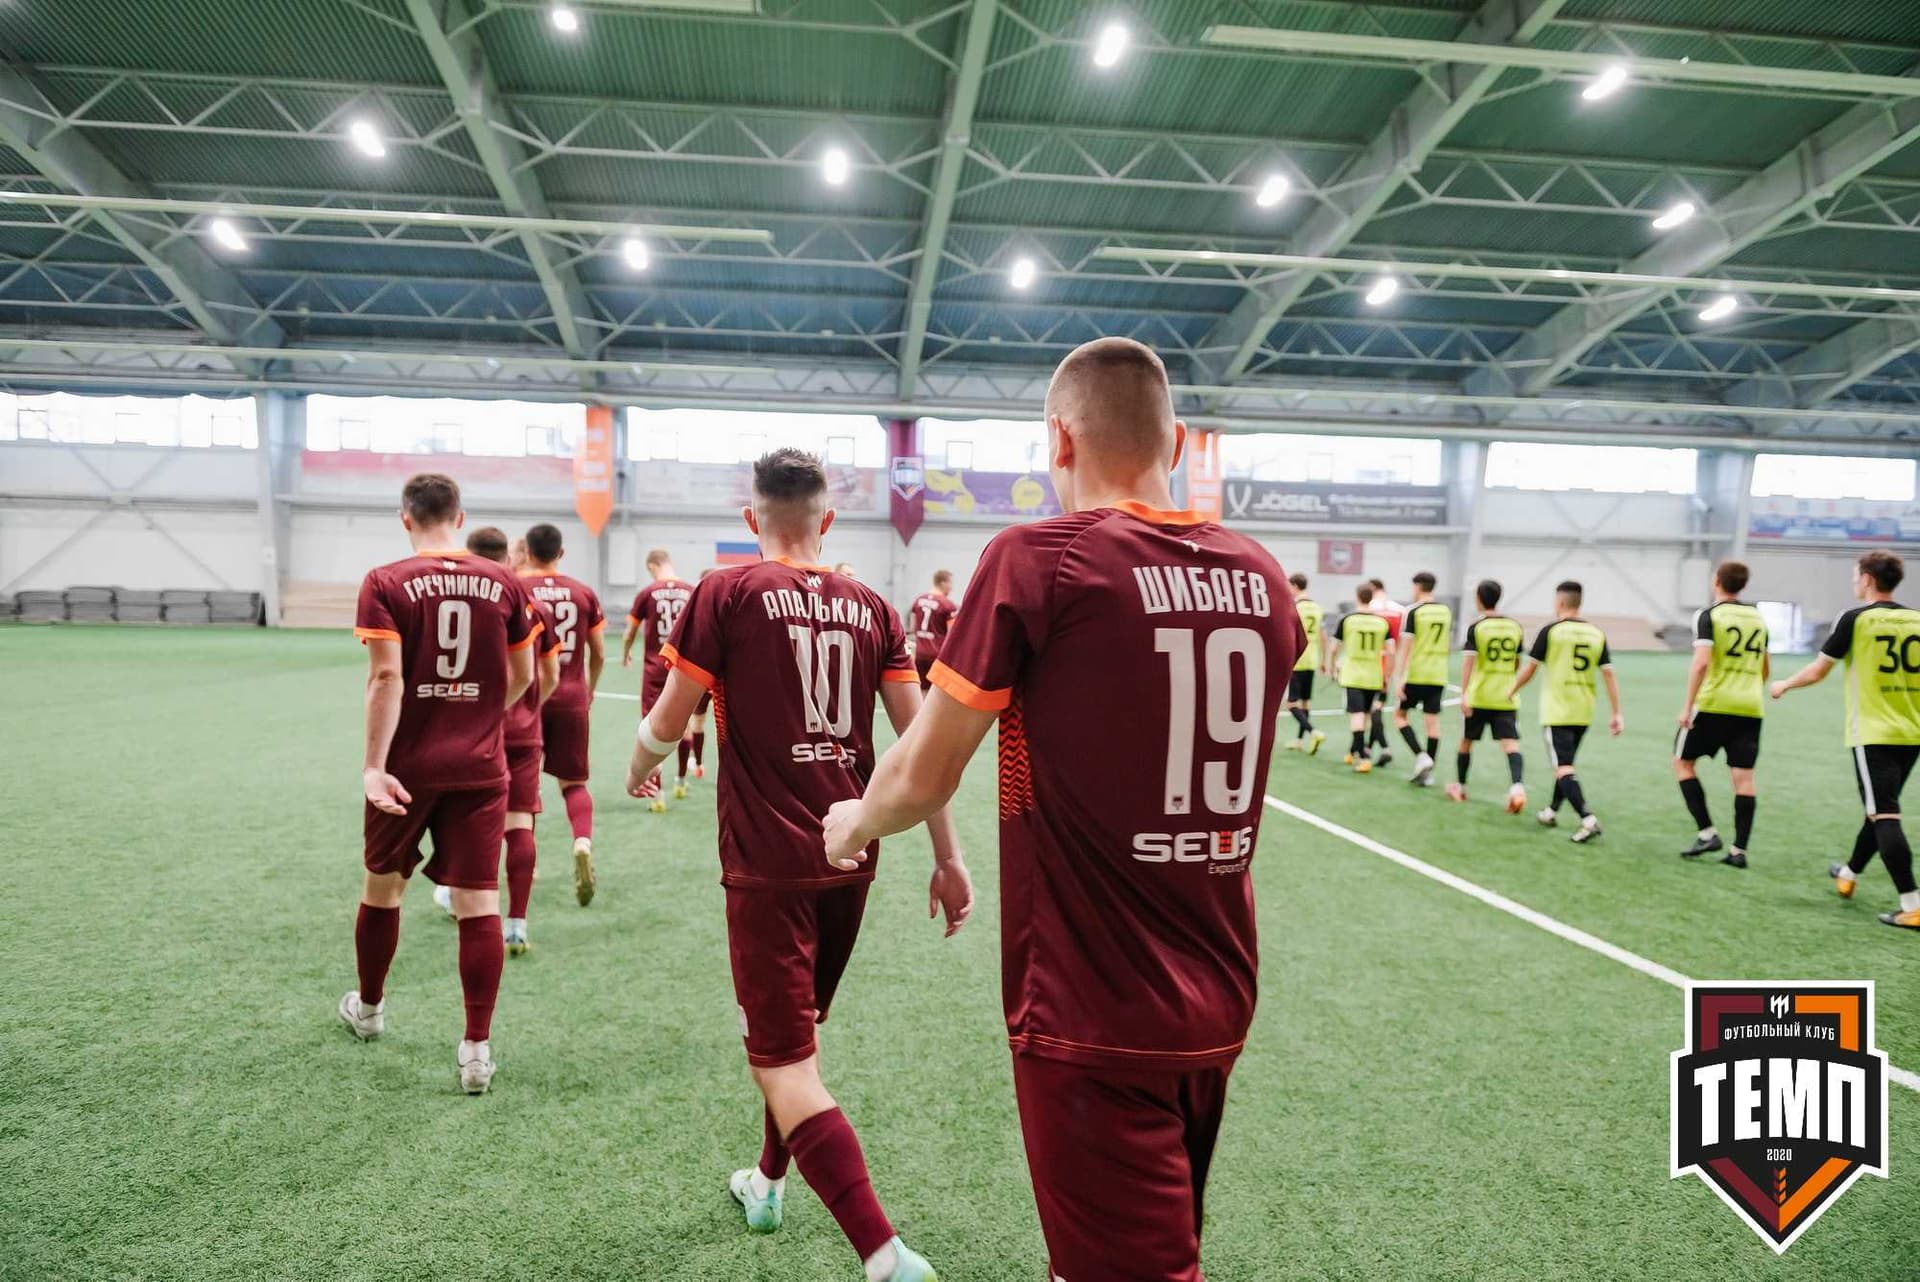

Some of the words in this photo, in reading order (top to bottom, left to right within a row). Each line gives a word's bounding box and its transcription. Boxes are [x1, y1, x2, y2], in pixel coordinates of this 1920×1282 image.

[403, 574, 504, 604] ГРЕЧНИКОВ
[1132, 566, 1271, 617] ШИБАЕВ
[543, 601, 578, 651] 2
[762, 589, 872, 632] АПАЛЬКИН
[436, 600, 471, 679] 9
[1358, 631, 1375, 650] 11
[1431, 623, 1444, 644] 7
[1487, 638, 1516, 662] 69
[1725, 627, 1763, 660] 24
[1573, 644, 1590, 672] 5
[1875, 635, 1920, 674] 30
[416, 682, 480, 698] SEUS
[787, 624, 854, 738] 10
[1154, 628, 1266, 815] 19
[1131, 826, 1253, 863] SEUS
